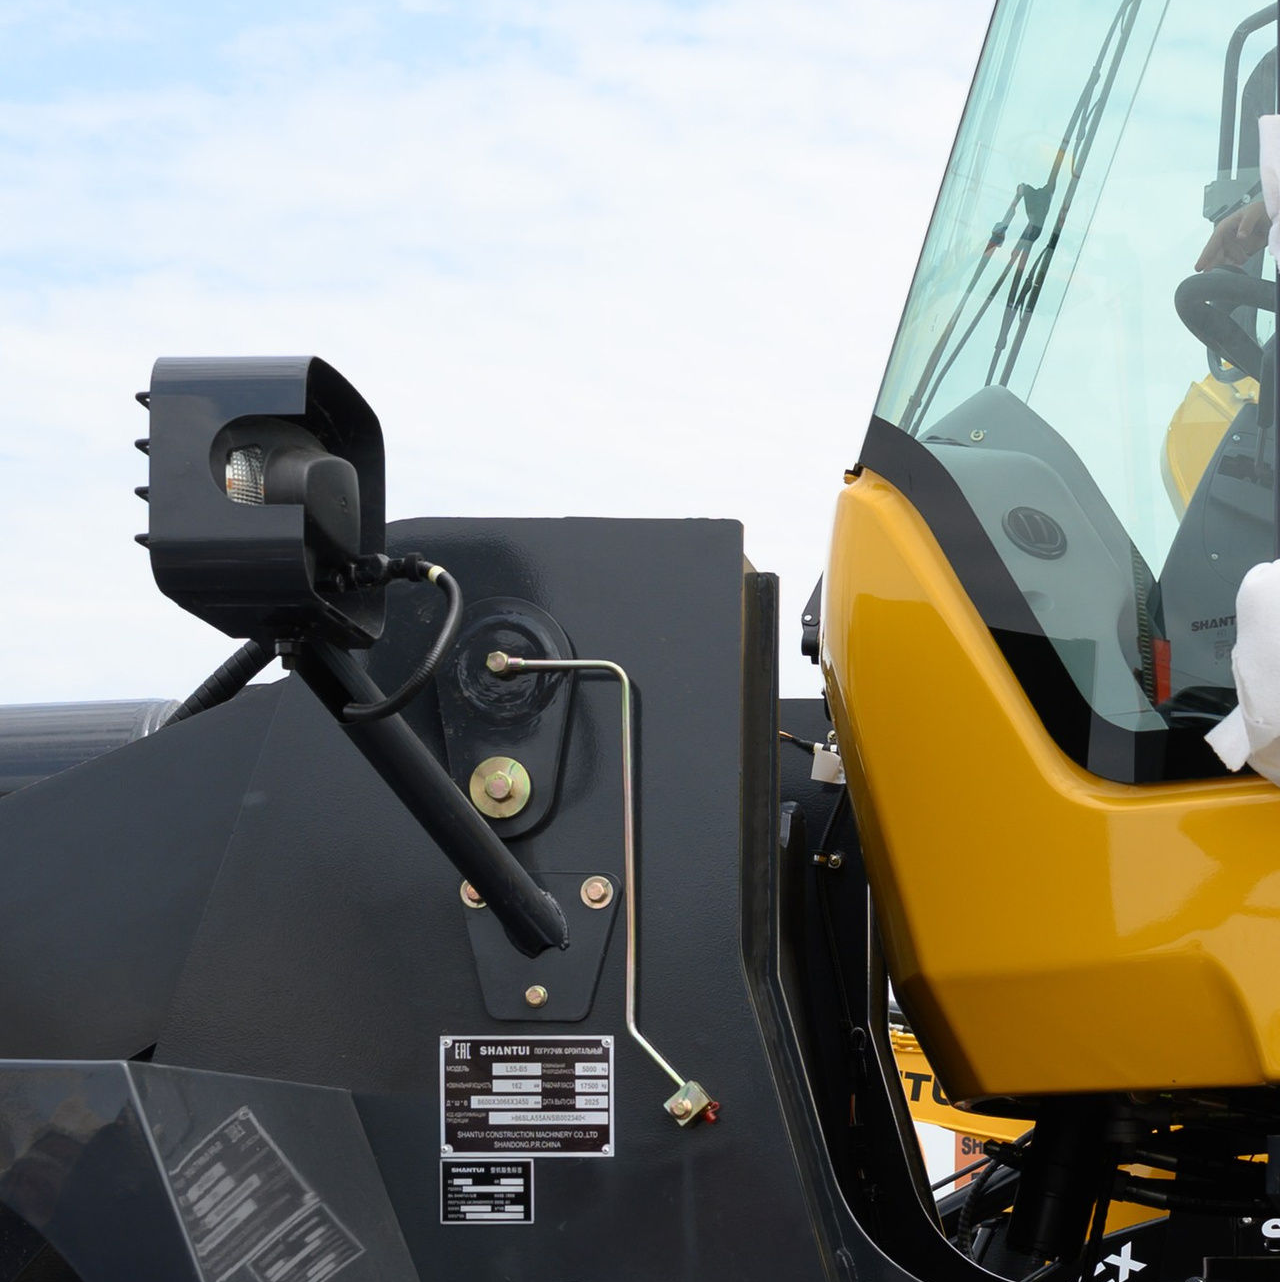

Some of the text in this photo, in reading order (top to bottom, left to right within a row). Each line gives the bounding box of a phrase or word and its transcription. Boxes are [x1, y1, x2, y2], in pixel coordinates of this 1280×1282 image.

[479, 1046, 530, 1056] SHANTUI
[582, 1065, 597, 1073] 5000
[584, 1098, 600, 1106] 2025
[457, 1131, 485, 1139] SHANTUI
[485, 1131, 535, 1139] CONSTRUCTION
[536, 1131, 572, 1139] MACHINERY
